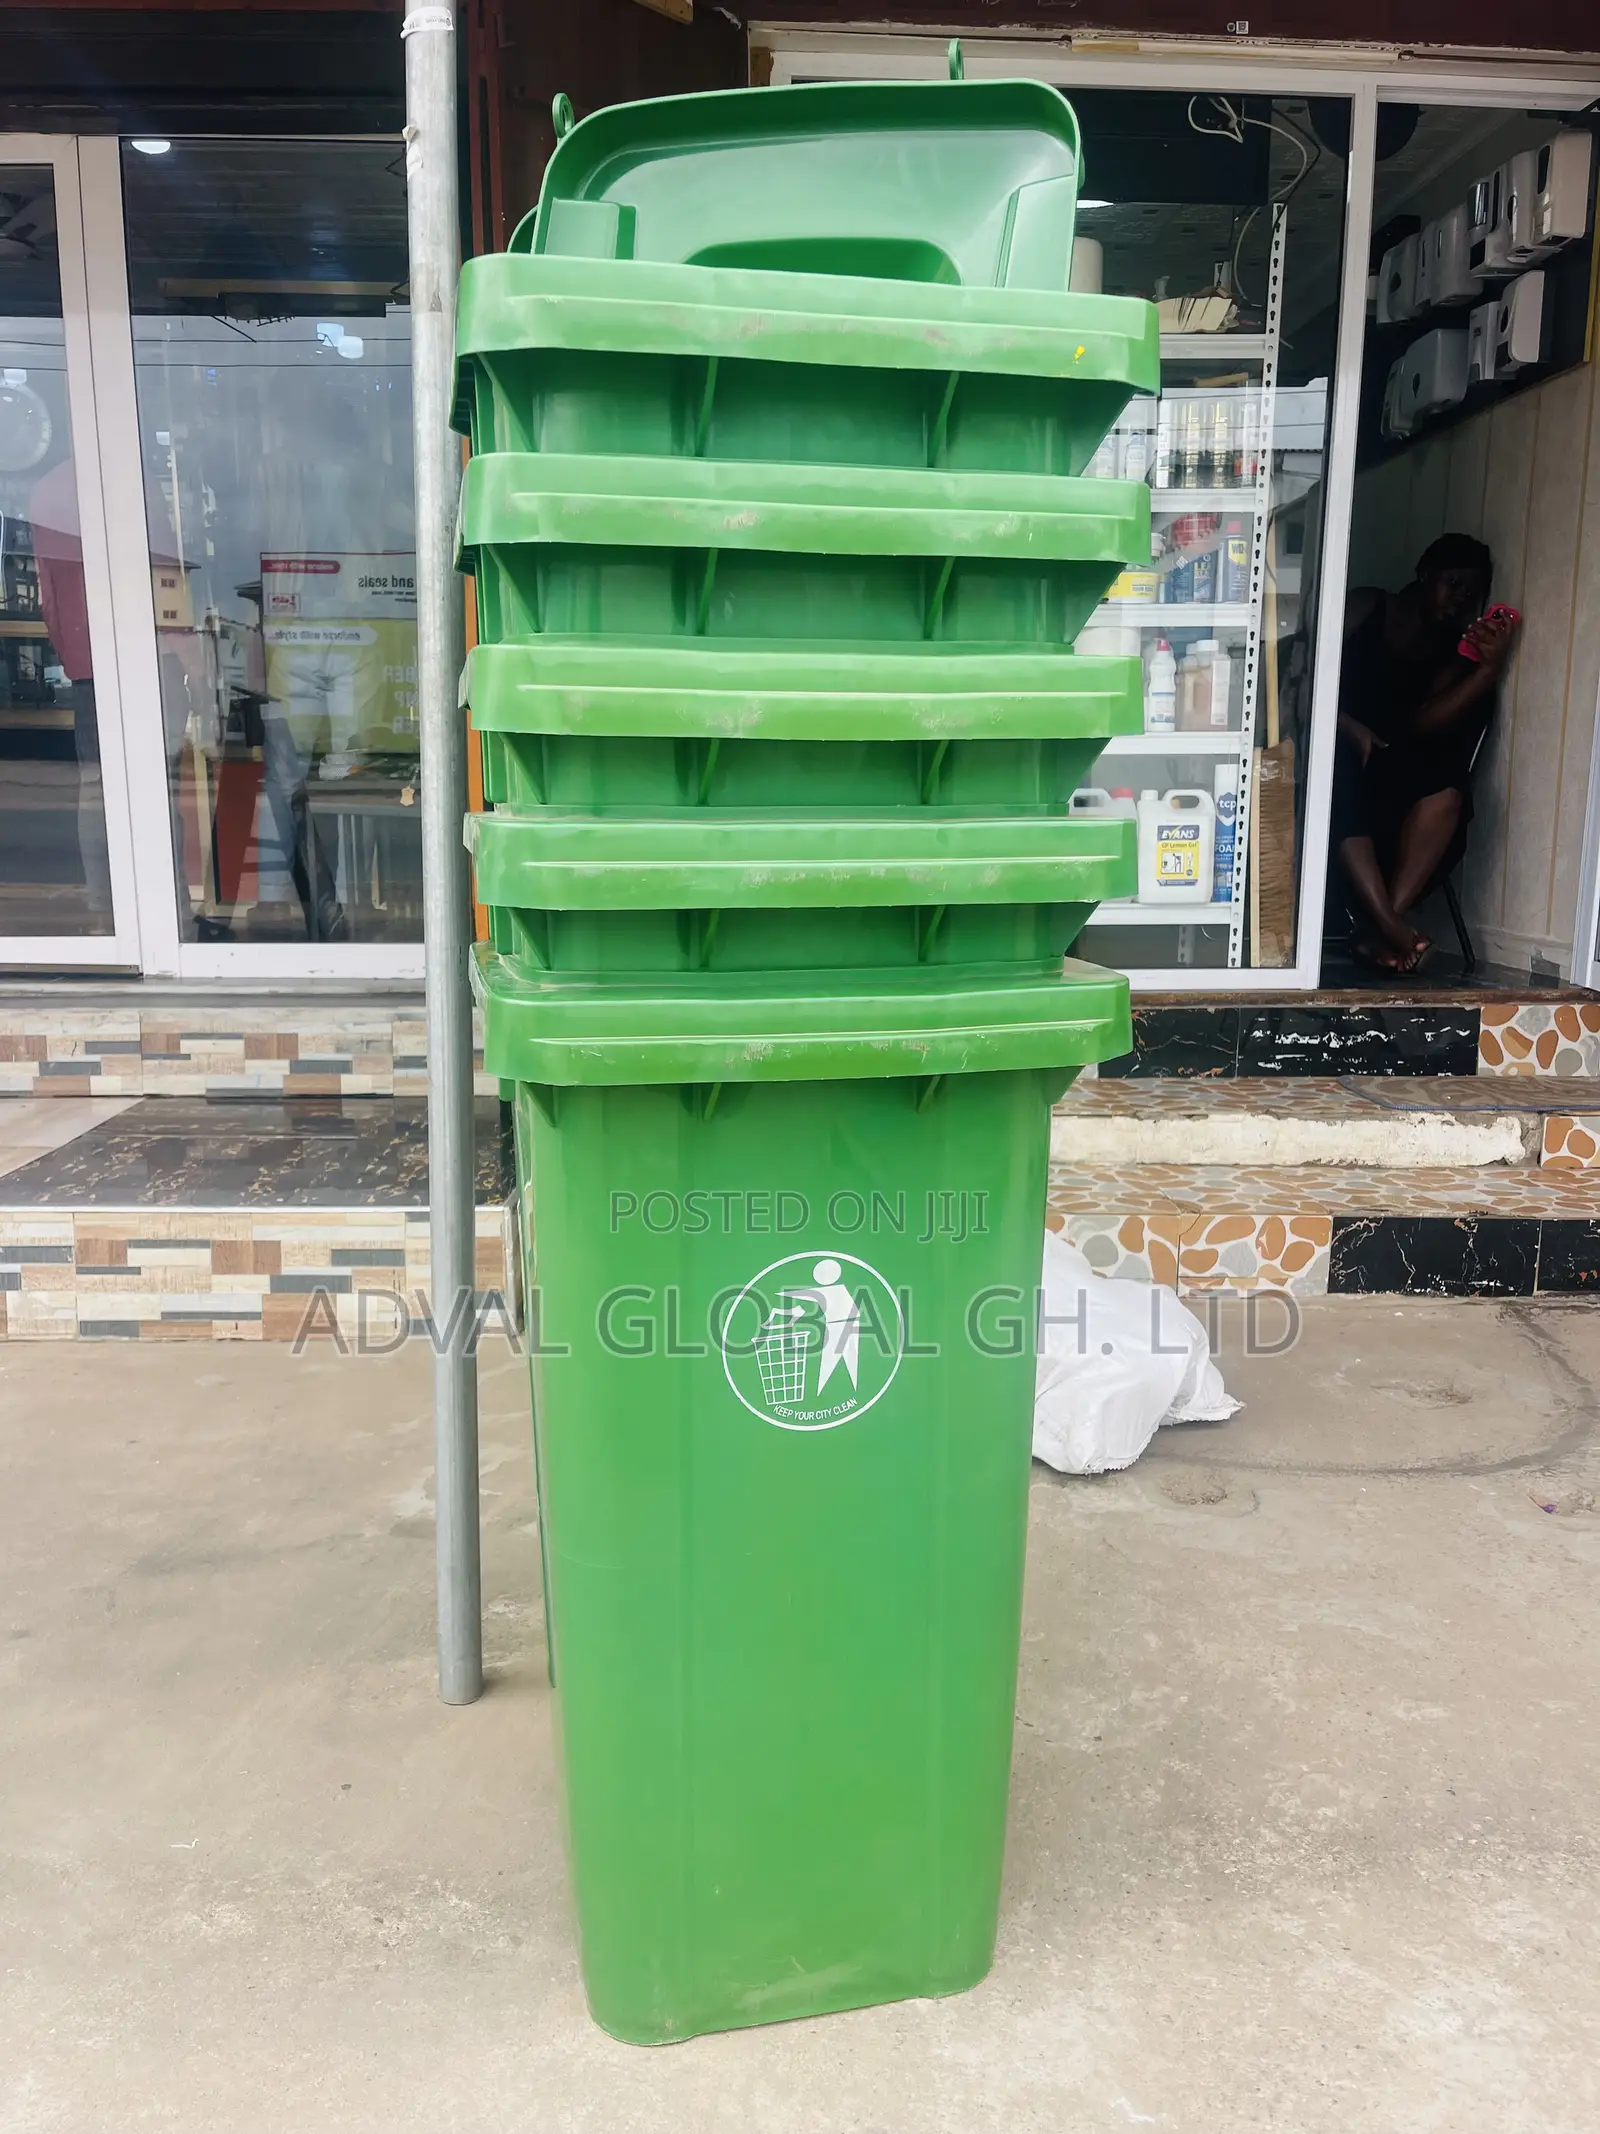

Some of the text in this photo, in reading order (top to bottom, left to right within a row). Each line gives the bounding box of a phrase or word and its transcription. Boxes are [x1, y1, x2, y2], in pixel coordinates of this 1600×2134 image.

[1162, 829, 1195, 839] EVANS
[773, 1398, 858, 1421] KEEP YOUR CITY CLEAN
